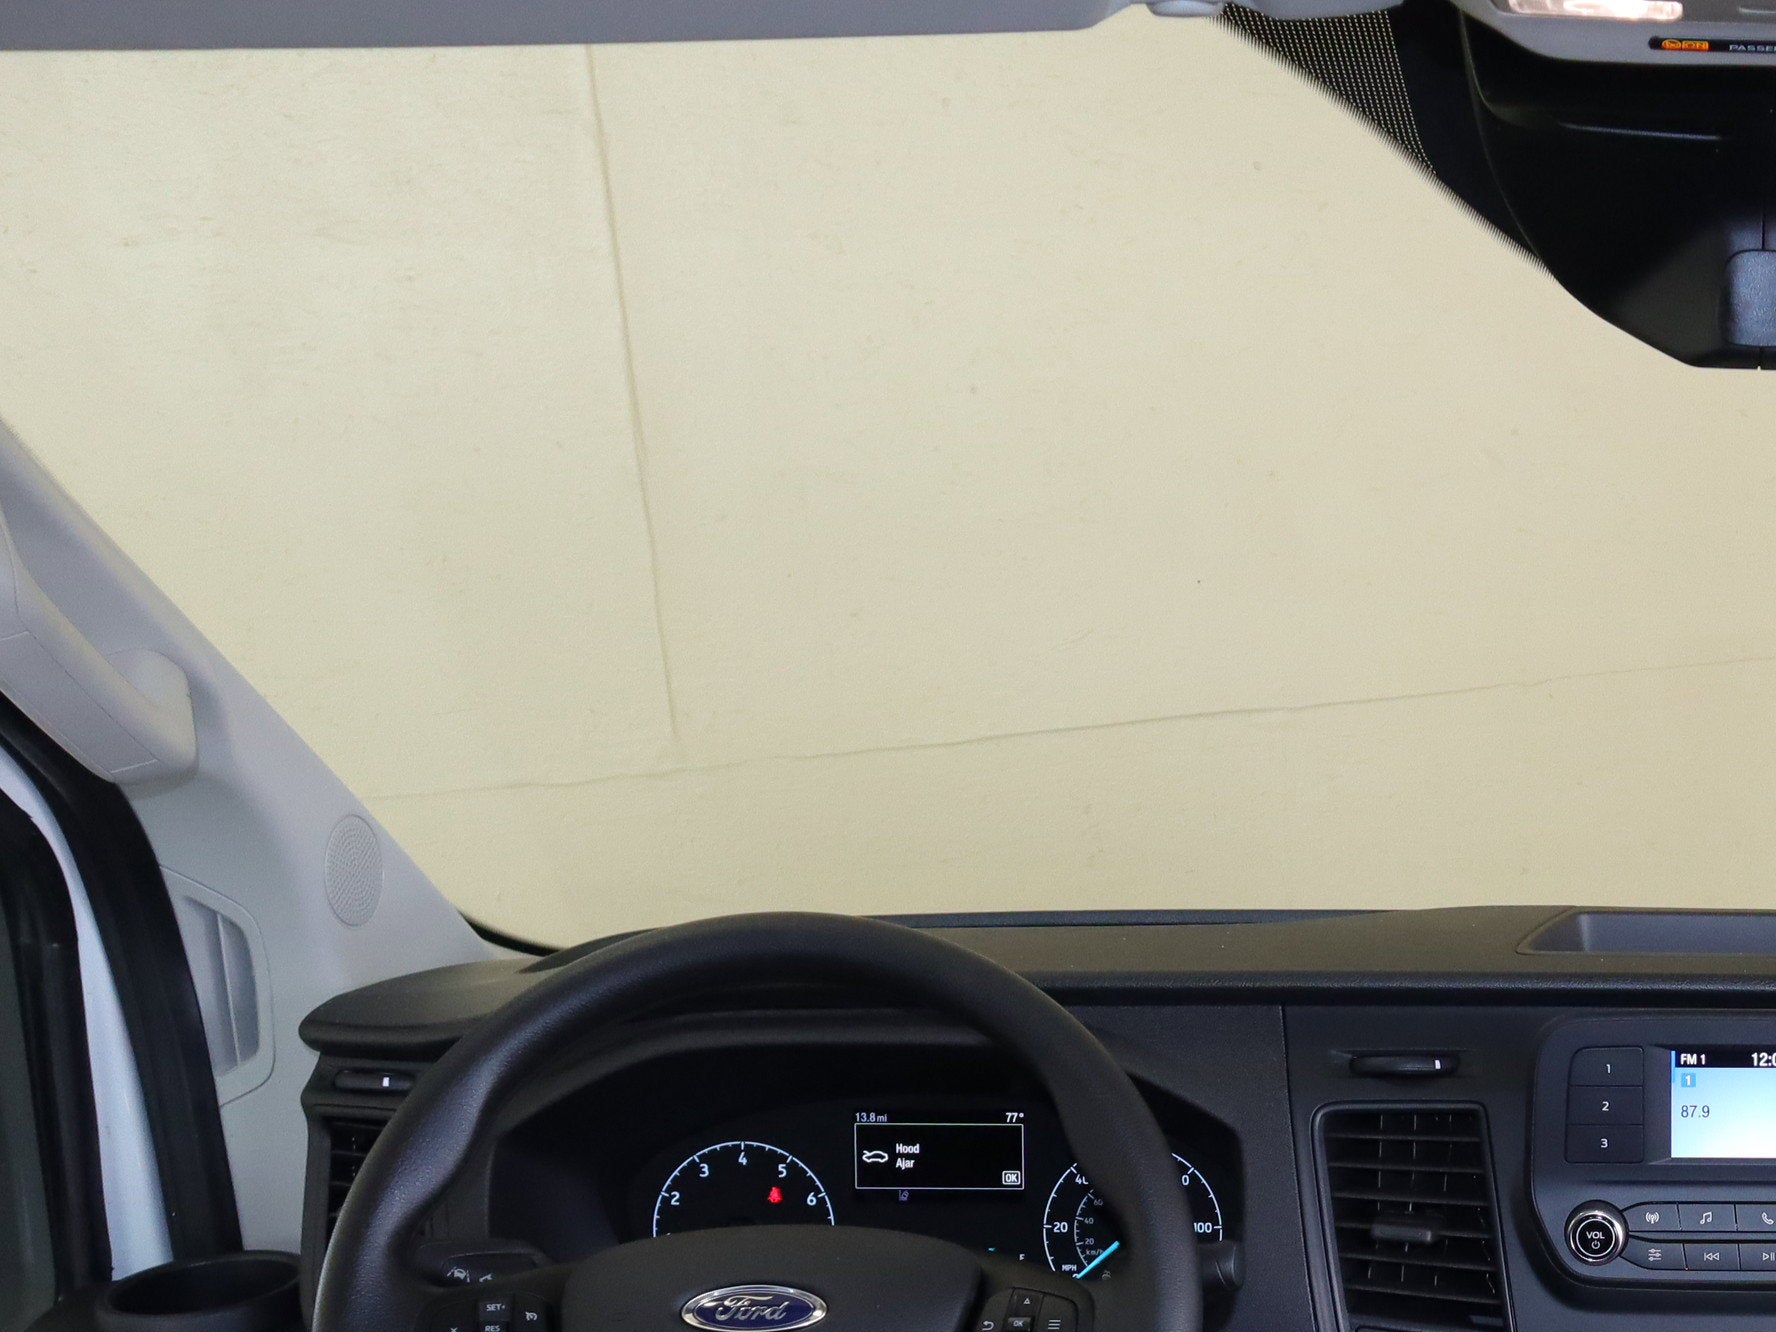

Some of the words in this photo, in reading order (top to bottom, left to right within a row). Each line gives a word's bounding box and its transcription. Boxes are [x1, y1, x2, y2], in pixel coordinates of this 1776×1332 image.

[1680, 1053, 1697, 1065] FM
[1700, 1053, 1706, 1065] 1
[1605, 1064, 1611, 1074] 1
[1601, 1101, 1610, 1111] 2
[1680, 1105, 1710, 1119] 87.9
[895, 1143, 920, 1154] Hood
[1600, 1138, 1609, 1149] 3
[737, 1152, 748, 1166] 4
[895, 1157, 915, 1170] Ajar
[699, 1163, 709, 1178] 3
[778, 1164, 788, 1178] 5
[1005, 1173, 1018, 1183] OK
[670, 1191, 681, 1205] 2
[806, 1191, 818, 1205] 6
[1084, 1217, 1094, 1225] 40
[1053, 1222, 1068, 1234] 20
[1193, 1221, 1213, 1234] 100
[1085, 1237, 1095, 1245] 20
[1586, 1231, 1605, 1239] VOL
[715, 1295, 791, 1321] Ford
[485, 1325, 500, 1332] RES
